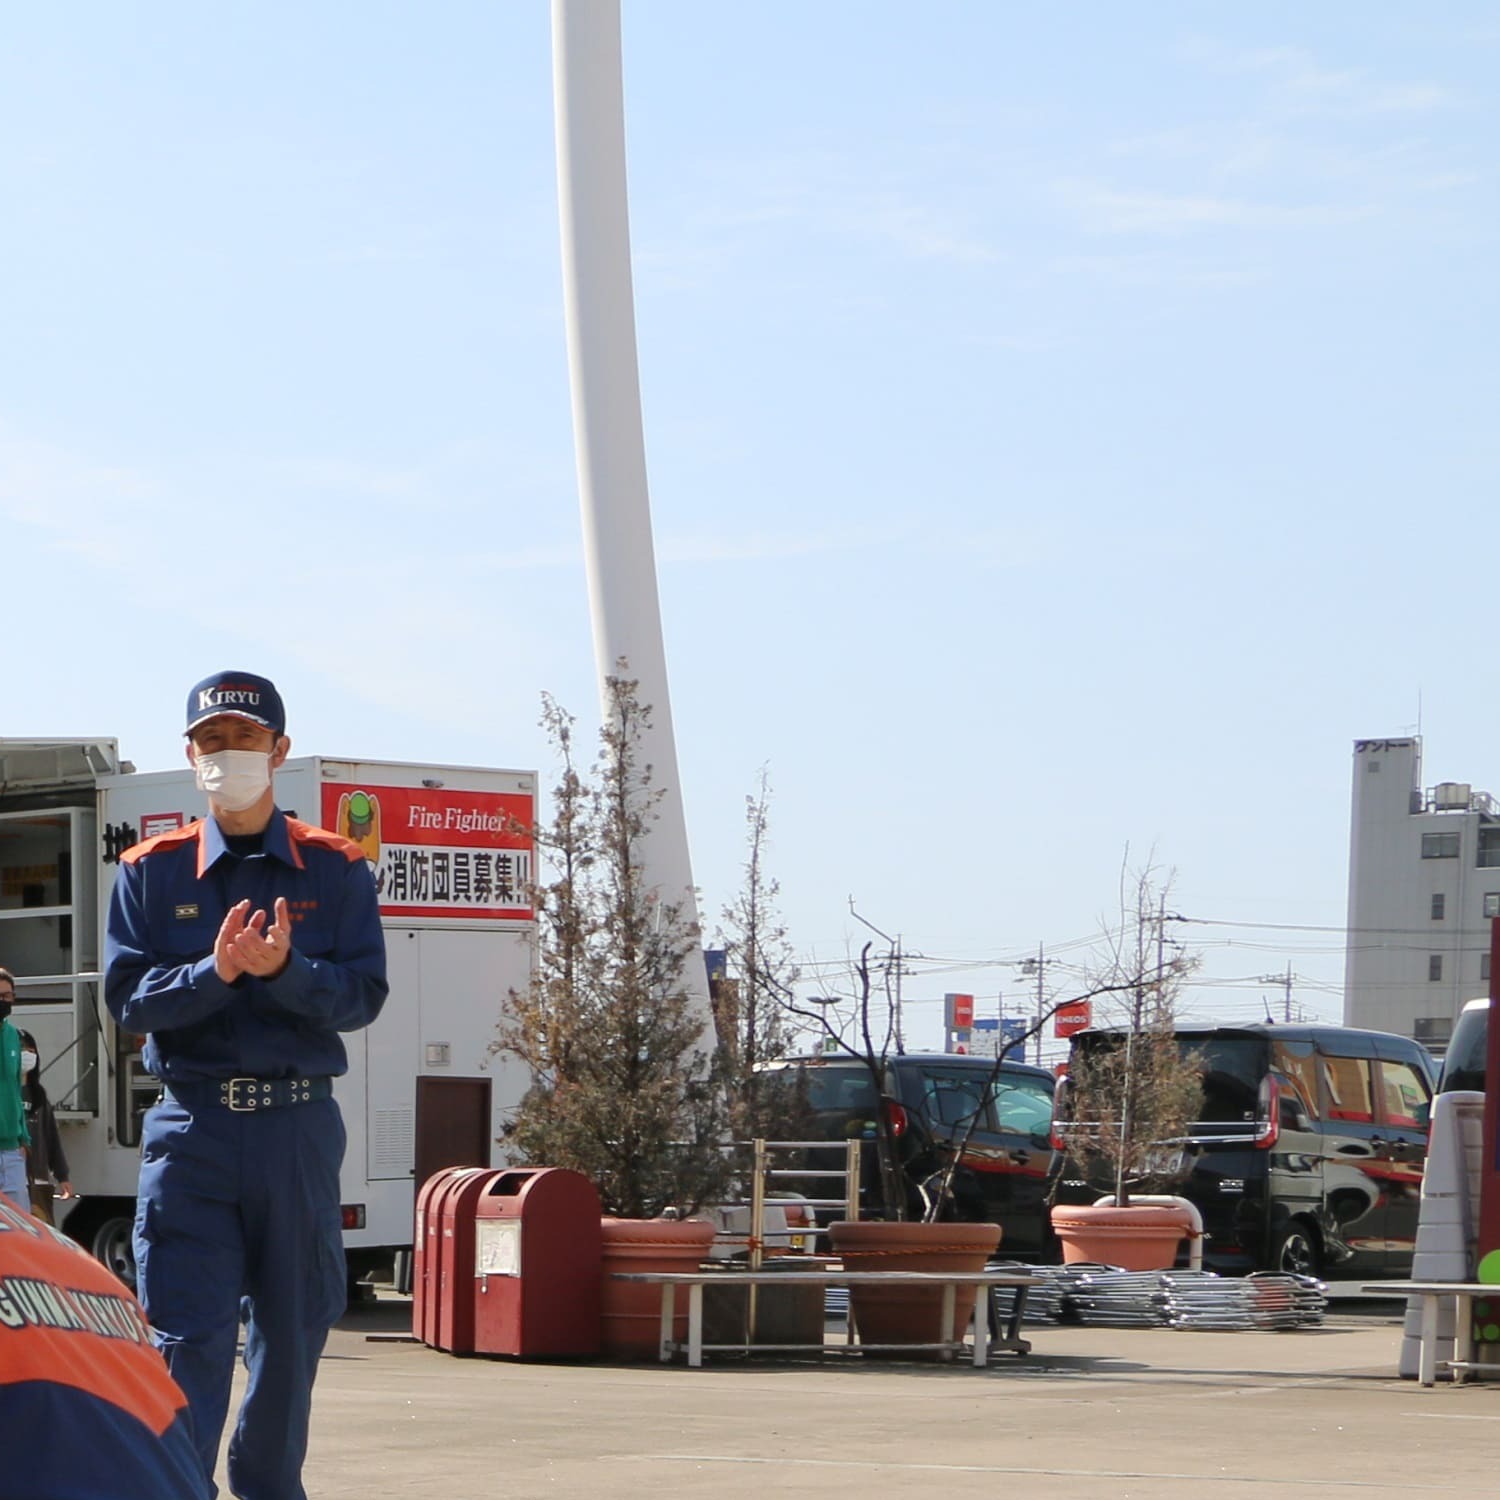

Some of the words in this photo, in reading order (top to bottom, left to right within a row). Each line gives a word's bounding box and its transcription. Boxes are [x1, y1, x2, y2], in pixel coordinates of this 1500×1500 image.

[198, 686, 260, 712] KIRYU
[407, 805, 443, 828] Fire
[444, 807, 507, 834] Fighter
